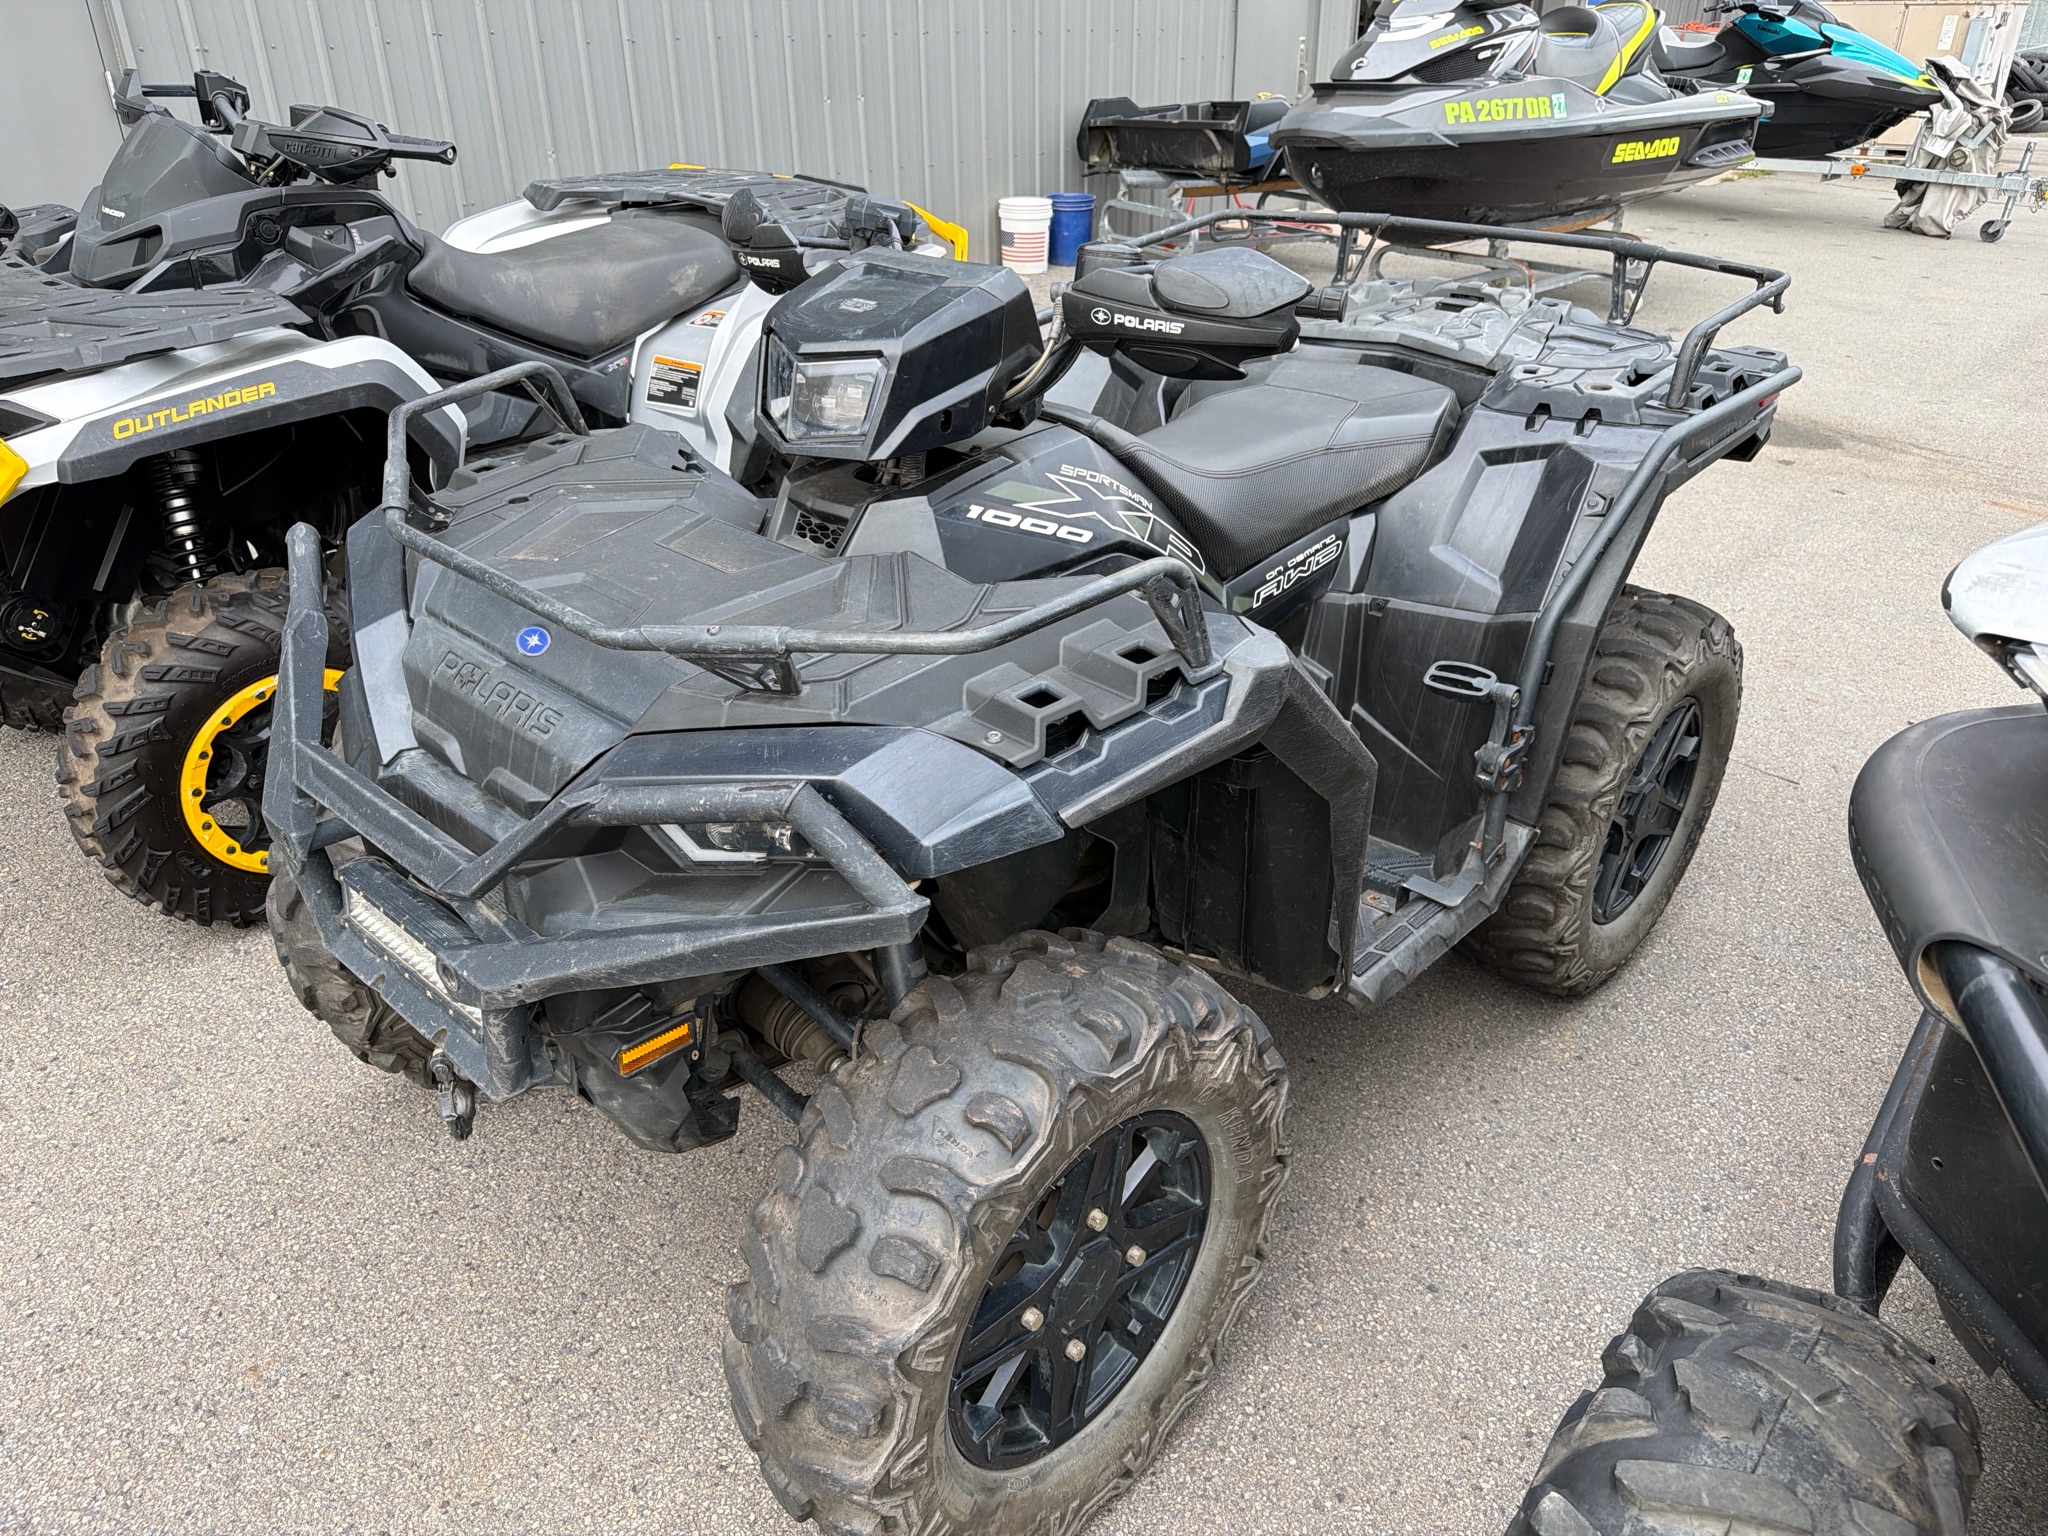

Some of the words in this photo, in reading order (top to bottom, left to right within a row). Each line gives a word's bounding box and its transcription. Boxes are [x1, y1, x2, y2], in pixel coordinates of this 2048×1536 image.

[1444, 101, 1476, 125] PA
[1476, 97, 1524, 122] 2677
[1525, 96, 1552, 119] DR
[747, 256, 781, 268] POLARIS
[1113, 313, 1185, 335] POLARIS
[113, 381, 276, 440] OUTLANDER
[1059, 463, 1153, 511] SPORTSMAN
[966, 504, 1094, 544] 1000
[1012, 472, 1206, 576] XP
[1252, 540, 1343, 609] AWD
[433, 650, 565, 741] POLARIS
[1216, 1106, 1254, 1184] KENDA
